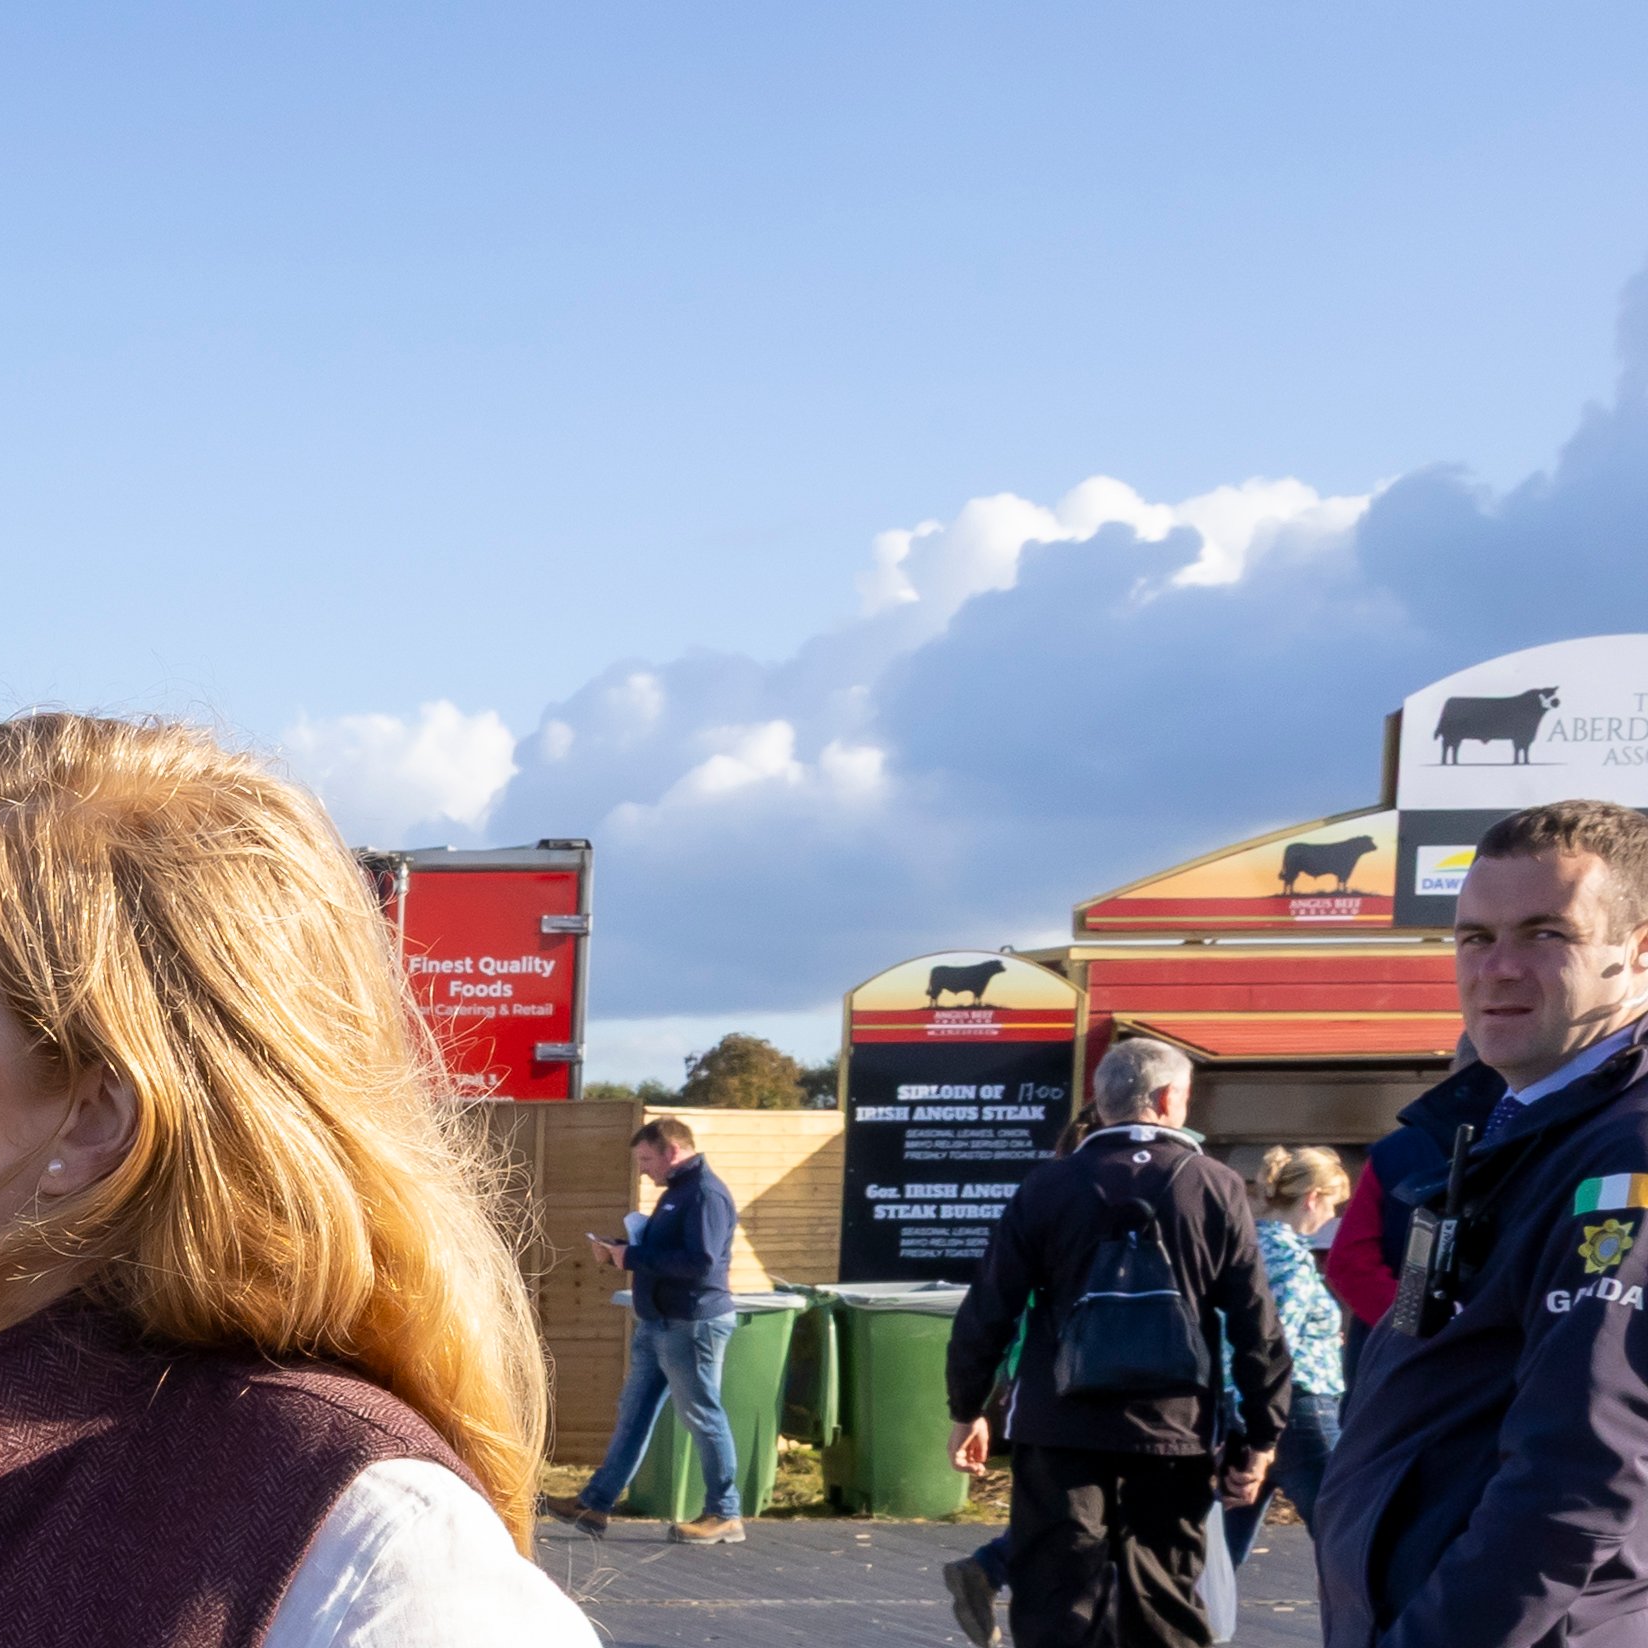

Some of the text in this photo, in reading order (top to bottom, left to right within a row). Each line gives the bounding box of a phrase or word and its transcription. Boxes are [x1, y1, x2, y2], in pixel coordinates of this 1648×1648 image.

[1602, 746, 1648, 767] ASS
[409, 956, 555, 978] Finest Quality
[449, 980, 513, 997] Foods
[435, 1004, 496, 1018] Catering
[499, 1004, 510, 1015] &
[512, 1003, 553, 1016] Retail
[897, 1085, 1005, 1100] SIRLOIN OF
[855, 1105, 1046, 1121] IRISH ANGUS STEAK
[904, 1184, 959, 1198] IRISH
[873, 1204, 936, 1219] STEAK
